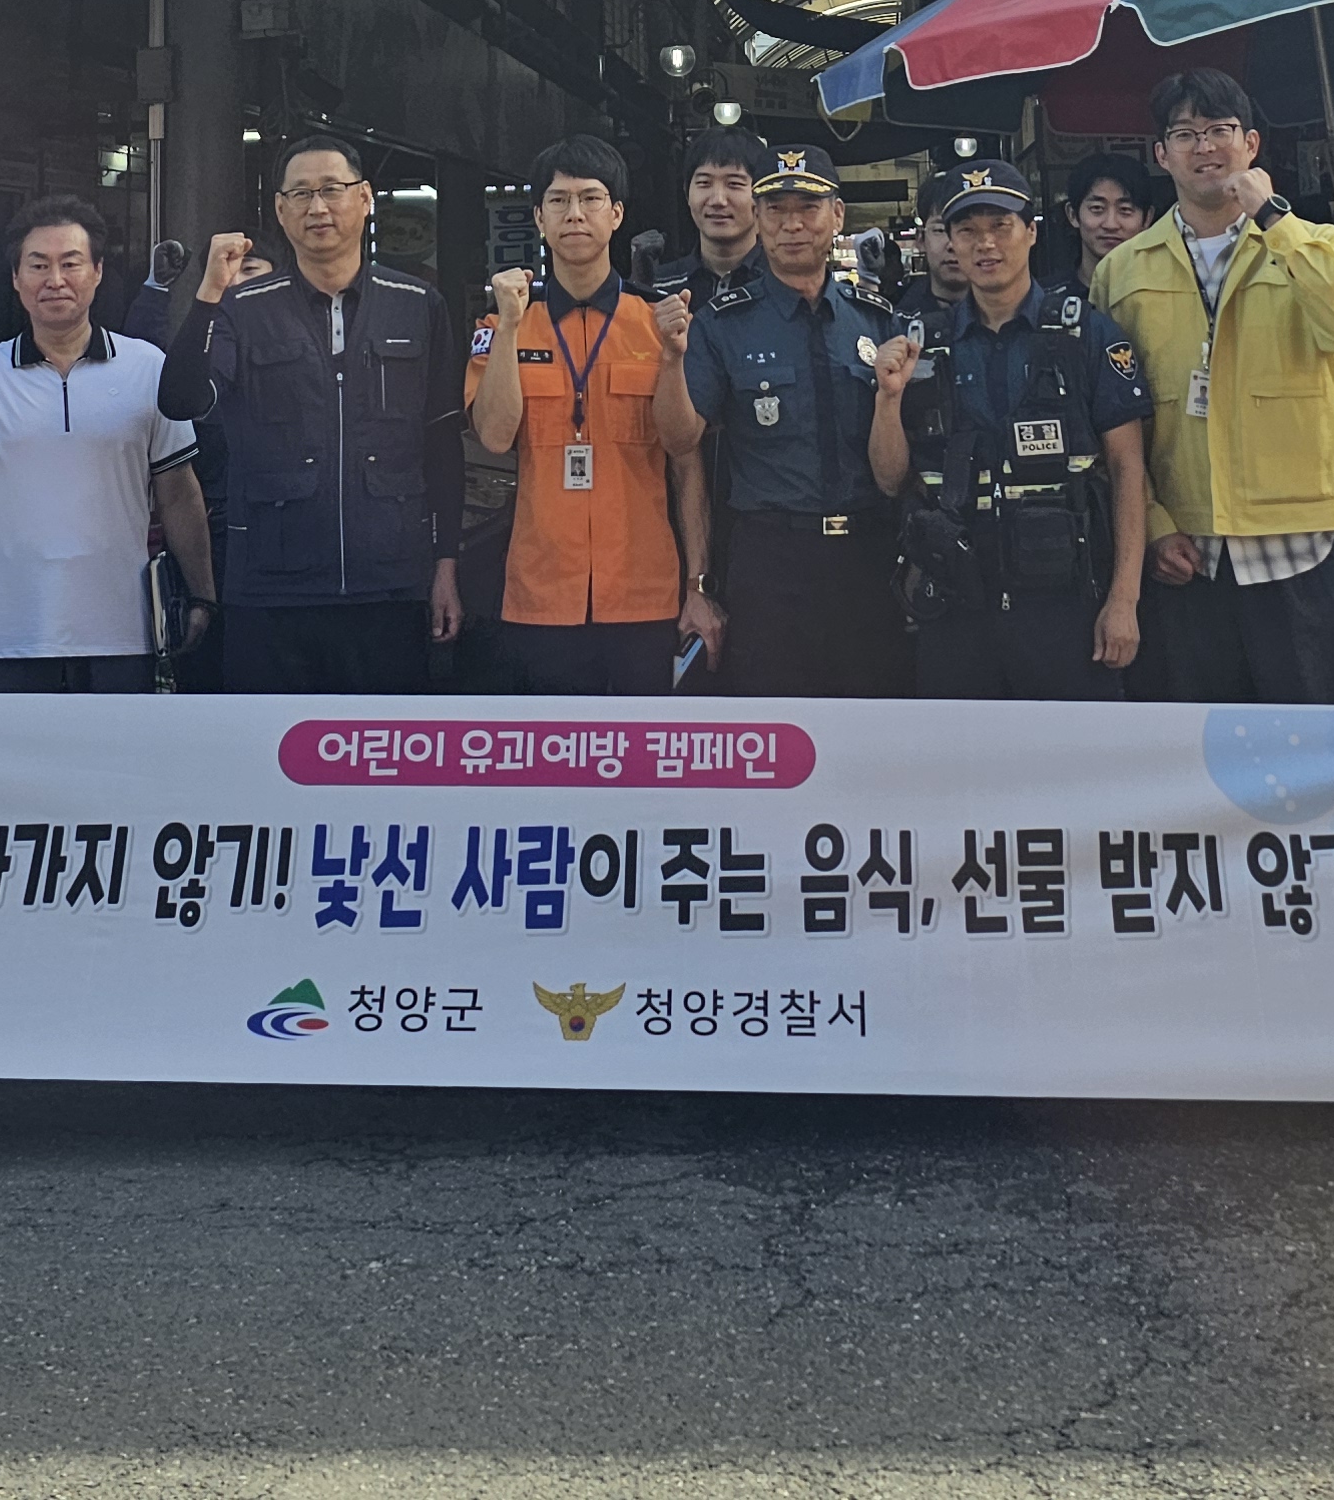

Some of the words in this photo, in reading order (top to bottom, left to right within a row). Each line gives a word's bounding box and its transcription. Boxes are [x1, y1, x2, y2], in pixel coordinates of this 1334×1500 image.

[1022, 441, 1058, 452] POLICE
[317, 729, 445, 777] 어린이
[459, 729, 630, 779] 유괴예방
[645, 731, 777, 780] 캠페인
[152, 821, 293, 928] 않기!
[311, 823, 430, 930] 낯선
[450, 825, 640, 930] 사람이
[660, 826, 766, 932] 주는
[800, 823, 935, 935] 음식,
[950, 827, 1066, 935] 선물
[1098, 830, 1223, 935] 받지
[347, 984, 484, 1034] 청양군
[634, 987, 869, 1039] 청양경찰서
